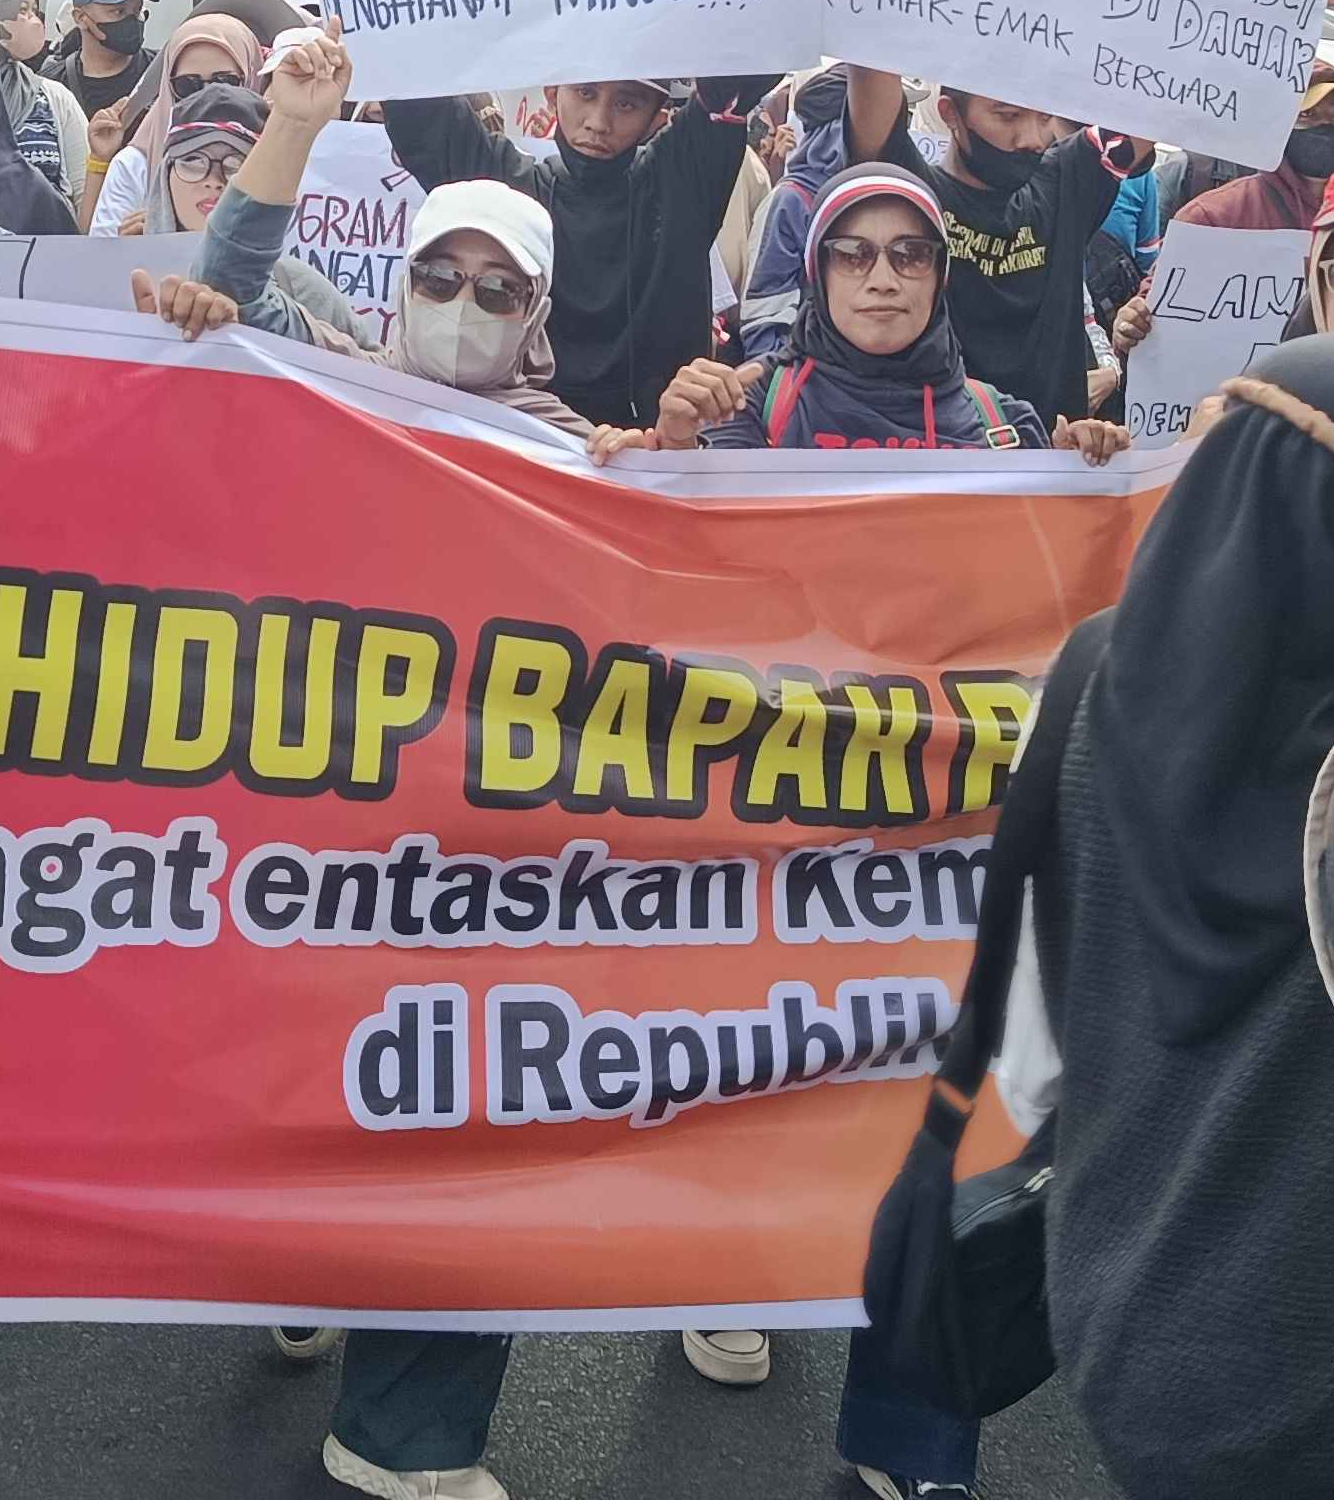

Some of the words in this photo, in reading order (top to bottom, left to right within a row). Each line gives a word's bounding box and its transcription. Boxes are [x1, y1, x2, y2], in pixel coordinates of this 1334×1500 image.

[1091, 42, 1240, 122] BERSUARA
[286, 193, 408, 249] GRAM
[243, 844, 759, 937] entaskan
[357, 1001, 459, 1118] di
